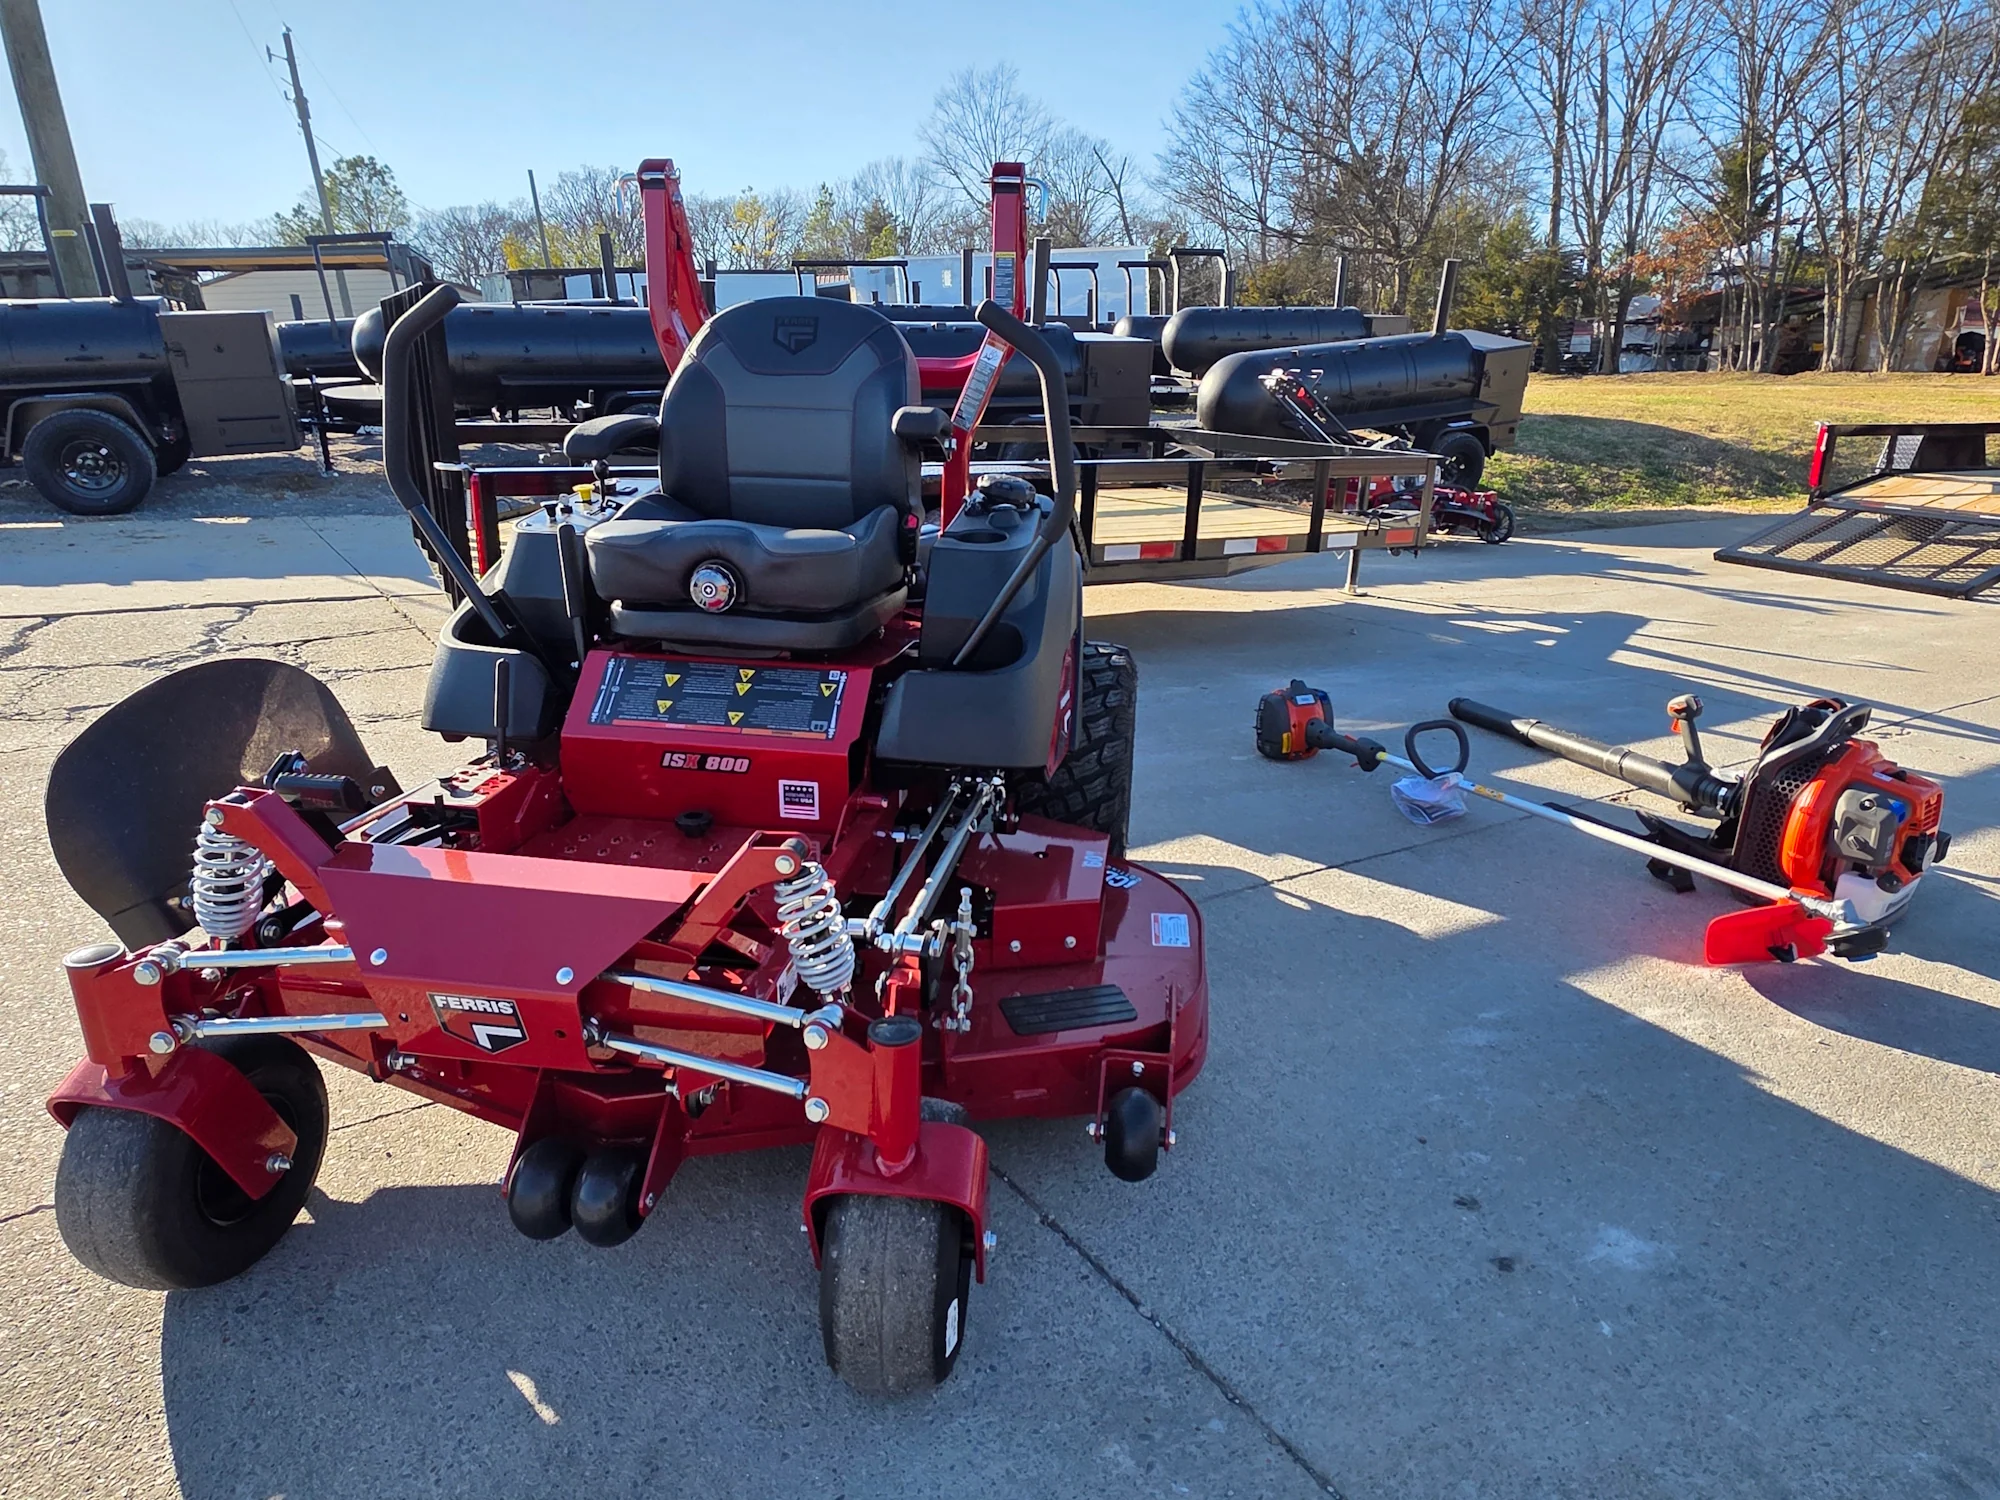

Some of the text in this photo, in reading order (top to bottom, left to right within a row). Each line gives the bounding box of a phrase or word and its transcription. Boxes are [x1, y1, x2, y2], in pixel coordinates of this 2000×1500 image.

[662, 753, 749, 772] ISX 800
[433, 995, 514, 1015] FERRIS
